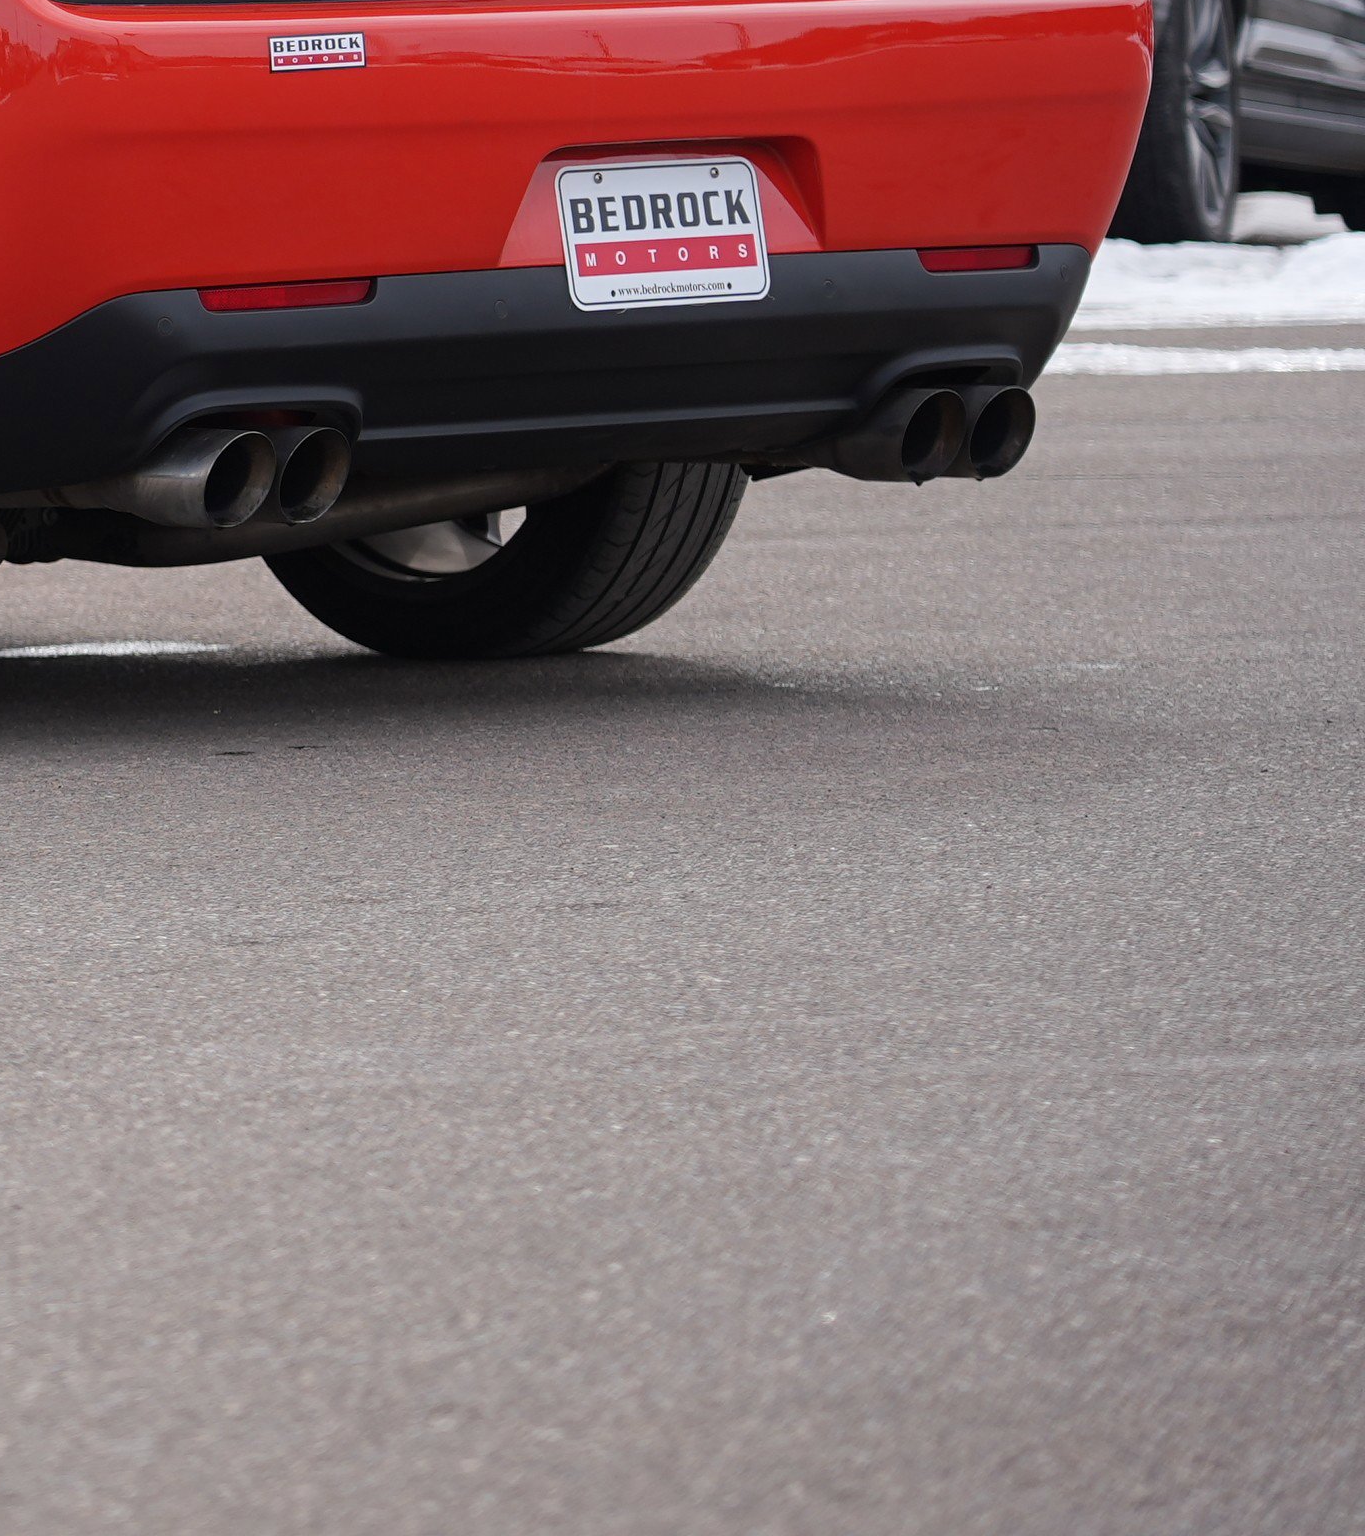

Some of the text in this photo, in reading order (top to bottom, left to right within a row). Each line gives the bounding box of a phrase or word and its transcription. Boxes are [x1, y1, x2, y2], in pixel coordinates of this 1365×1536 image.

[272, 36, 361, 53] BEDROCK
[277, 54, 359, 64] MOTORS
[570, 189, 751, 234] BEDROCK
[585, 243, 748, 268] MOTORS
[618, 280, 726, 297] www.bedrockmotors.com
